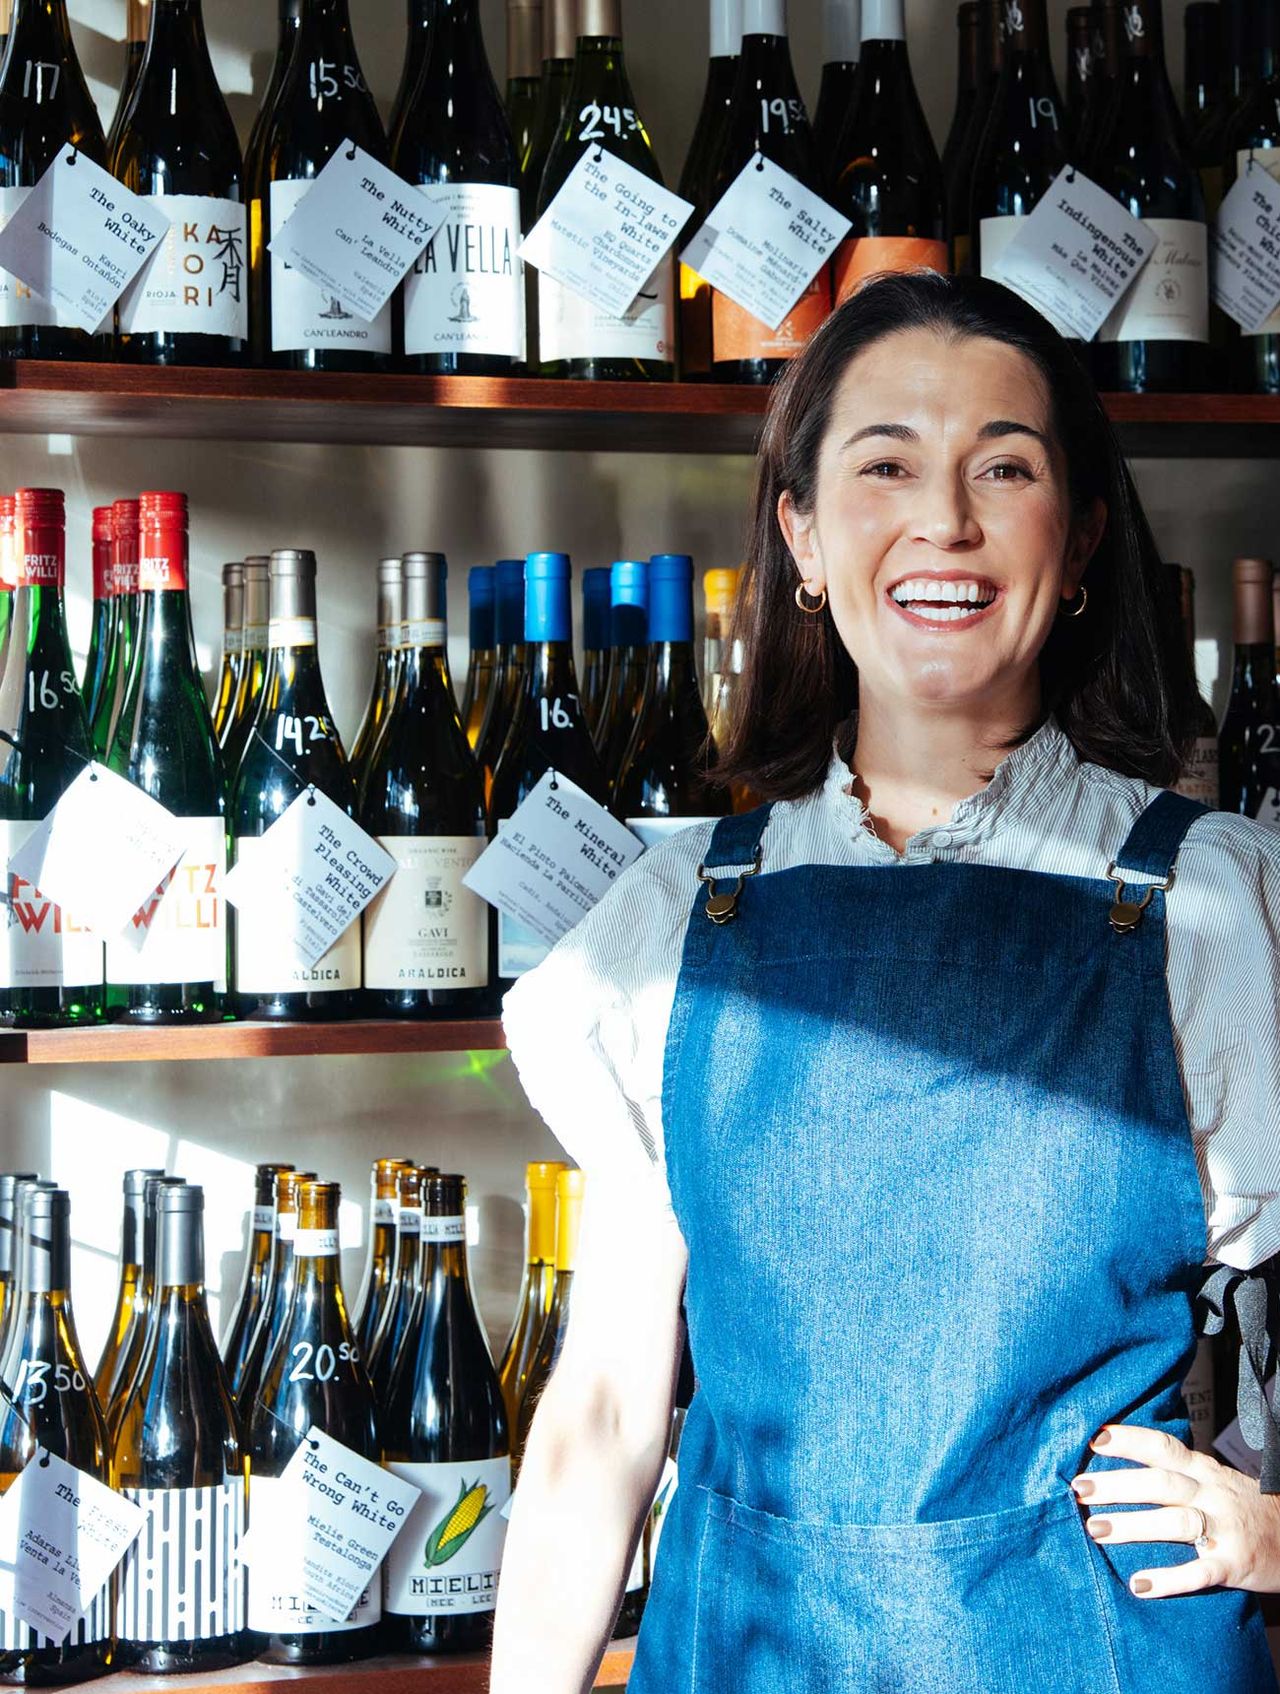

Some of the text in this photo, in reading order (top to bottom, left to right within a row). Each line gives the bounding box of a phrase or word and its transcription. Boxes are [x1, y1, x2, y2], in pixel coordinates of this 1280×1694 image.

[1029, 98, 1058, 131] 19
[361, 177, 385, 201] The
[390, 199, 433, 233] Nutty
[584, 162, 677, 228] The Going to
[584, 180, 668, 240] the In-laws
[1252, 191, 1273, 213] The
[90, 187, 156, 242] The Oaky
[381, 212, 423, 246] White
[768, 187, 836, 243] The Salty
[104, 218, 146, 256] White
[362, 234, 406, 269] La Vella
[620, 222, 660, 253] White
[787, 220, 827, 256] White
[1122, 232, 1145, 256] The
[82, 256, 122, 289] Ontañón
[99, 254, 127, 280] Kaori
[361, 247, 401, 278] Leandro
[1092, 243, 1129, 279] White
[146, 291, 177, 299] RIOJA
[24, 554, 57, 566] FRITZ
[26, 565, 57, 578] WILLI
[545, 795, 626, 867] The Mineral
[319, 825, 382, 886] The Crowd
[499, 837, 541, 871] Hacienda
[542, 870, 555, 884] La
[511, 832, 557, 869] El Pinto
[579, 844, 617, 880] White
[314, 843, 371, 899] Pleasing
[314, 883, 334, 906] Gavi
[324, 873, 361, 910] White
[292, 891, 339, 936] Castelvero
[417, 926, 449, 939] GAVI
[399, 967, 467, 979] ARALDICA
[54, 1483, 80, 1508] The
[301, 1471, 397, 1532] Wrong White
[302, 1450, 405, 1518] The Can't Go
[25, 1530, 62, 1558] Adaras
[306, 1514, 379, 1562] Mielie Green
[312, 1531, 372, 1572] Testalonga
[19, 1541, 67, 1577] Venta la
